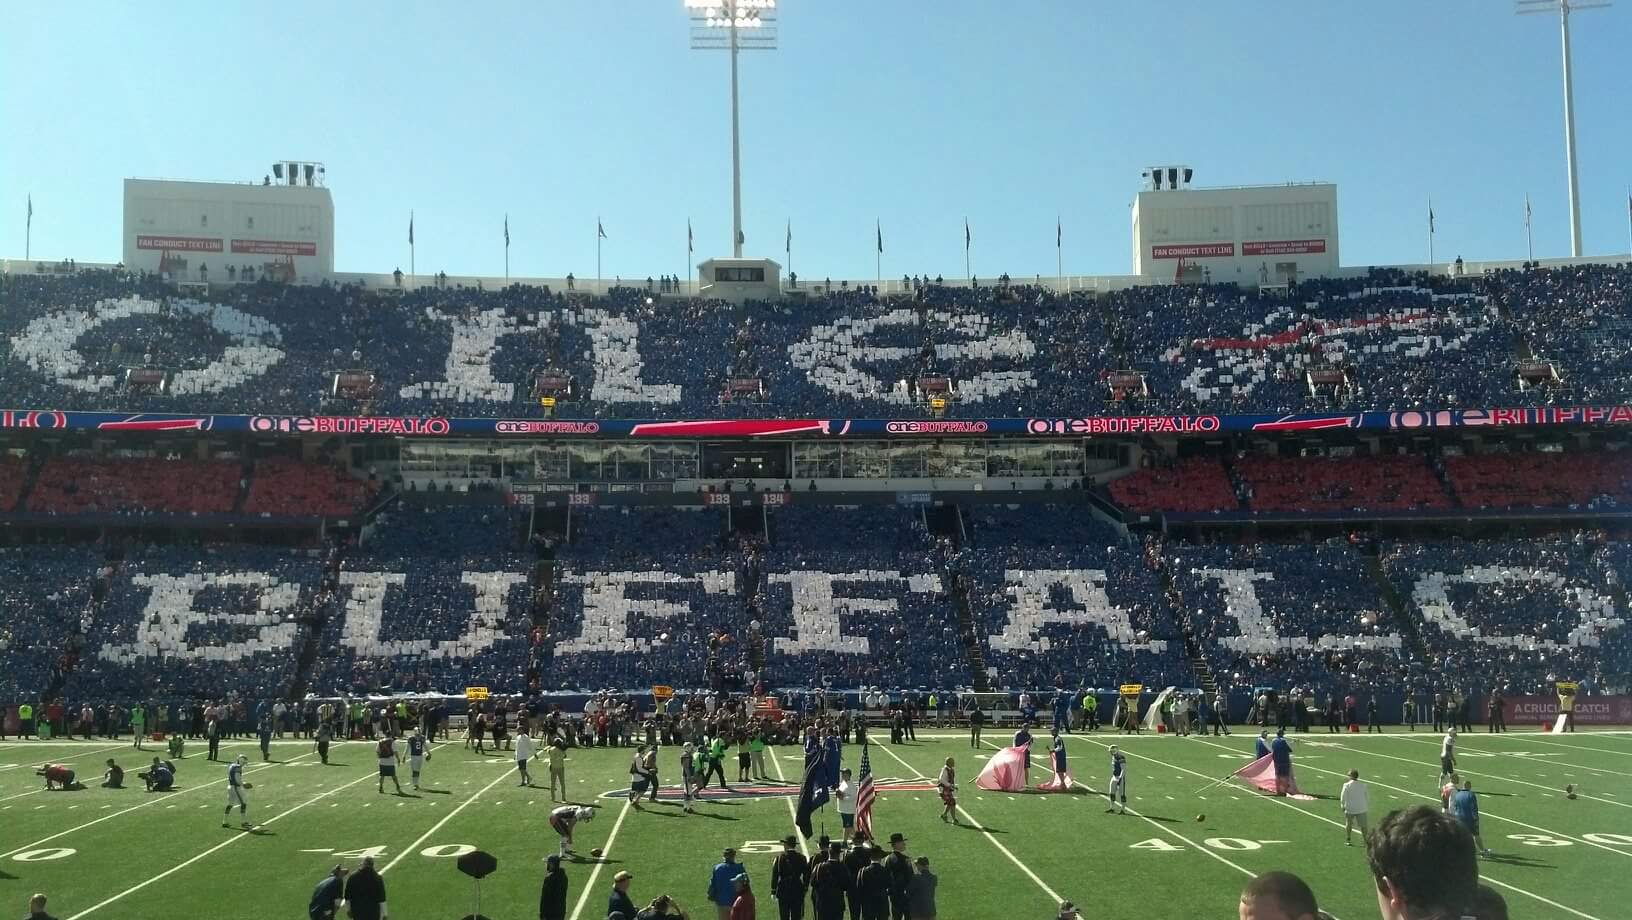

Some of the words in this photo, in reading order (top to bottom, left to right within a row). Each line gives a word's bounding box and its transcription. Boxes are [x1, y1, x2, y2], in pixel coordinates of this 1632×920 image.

[138, 239, 153, 247] FAN
[153, 240, 187, 248] CONDUCT
[188, 241, 205, 249] TEXT
[1154, 248, 1168, 256] FAN
[1168, 247, 1200, 256] CONDUCT
[1200, 246, 1217, 254] TEXT
[1217, 246, 1233, 254] LINE
[568, 493, 590, 505] 133
[709, 493, 731, 505] 133
[763, 493, 784, 505] 134
[1514, 703, 1523, 713] A
[1574, 703, 1610, 713] CATCH
[1129, 837, 1262, 852] 40
